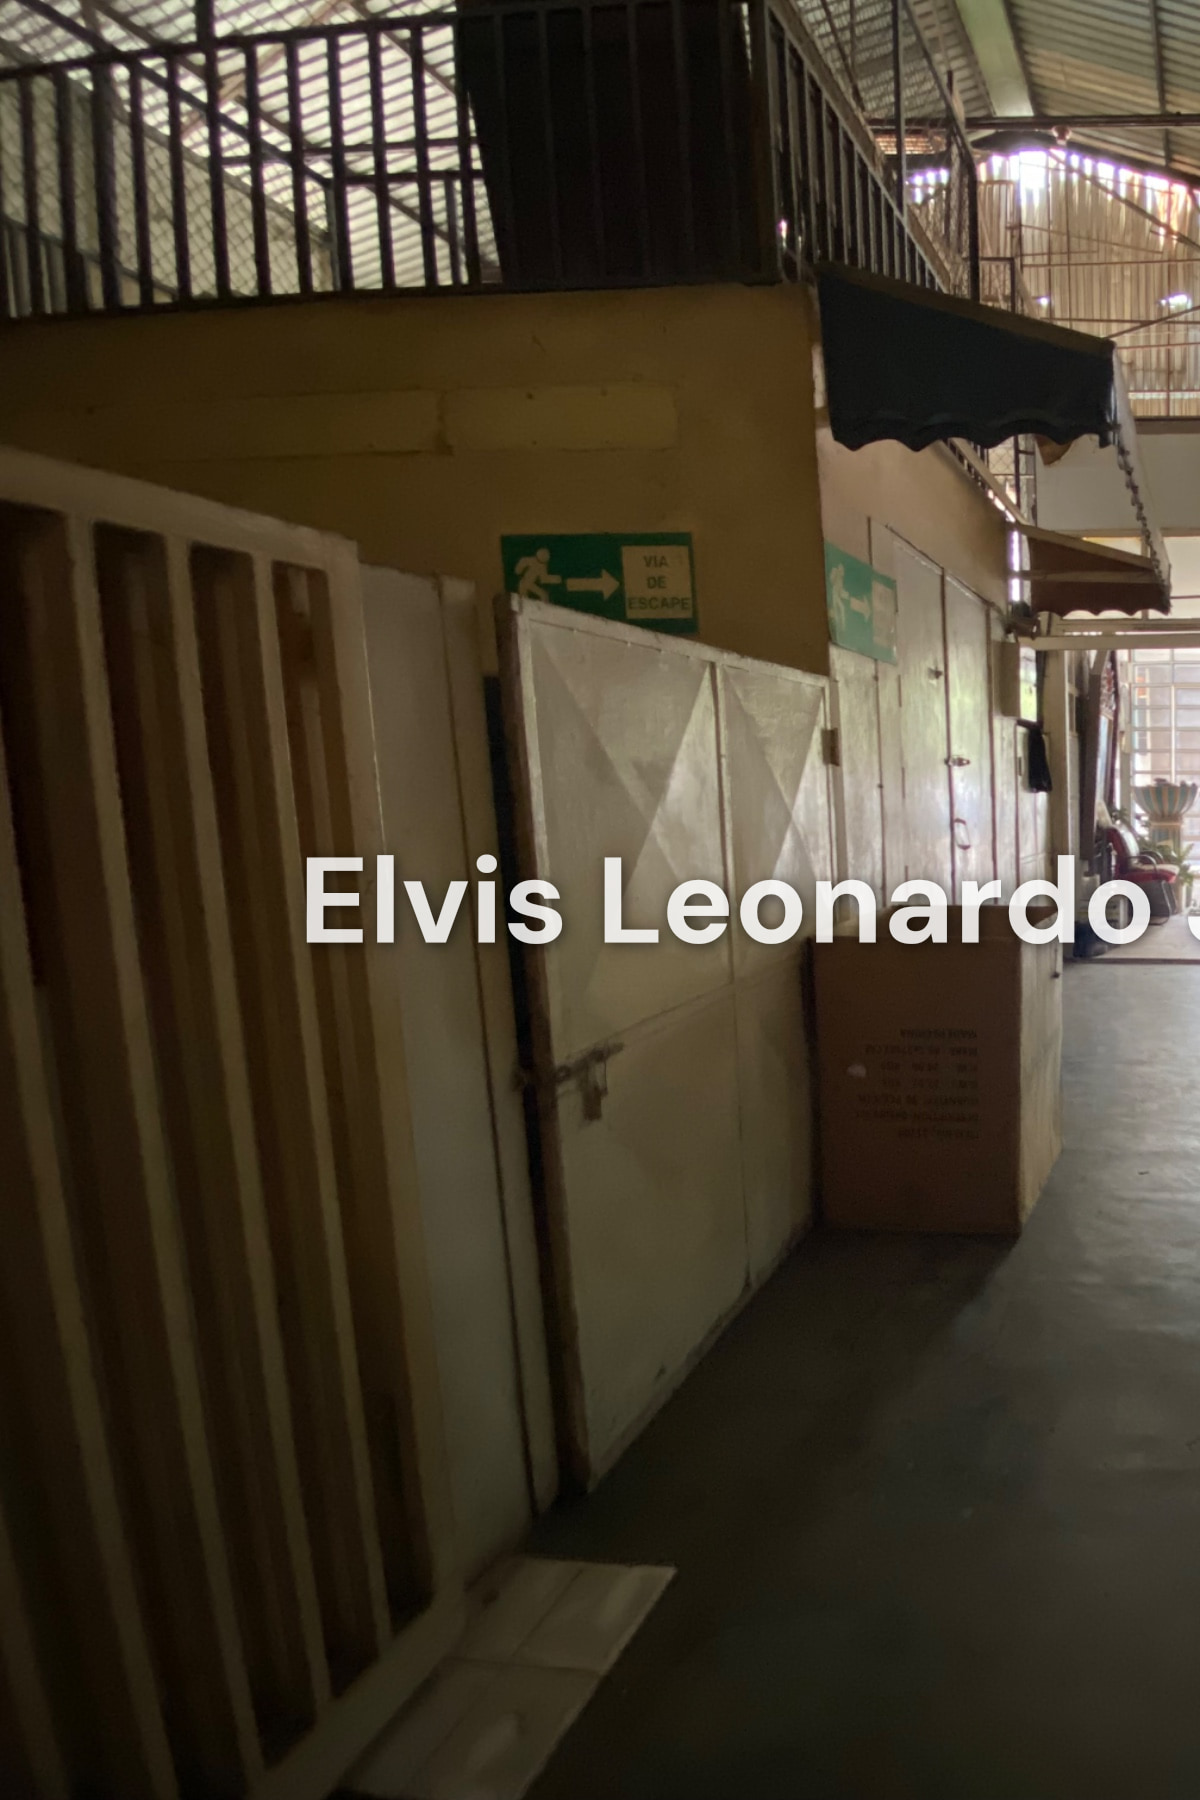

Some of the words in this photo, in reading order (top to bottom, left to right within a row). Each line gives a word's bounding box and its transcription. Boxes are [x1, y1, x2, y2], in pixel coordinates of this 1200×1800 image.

[643, 555, 669, 568] VIA
[646, 575, 668, 589] DE
[628, 596, 691, 610] ESCAPE
